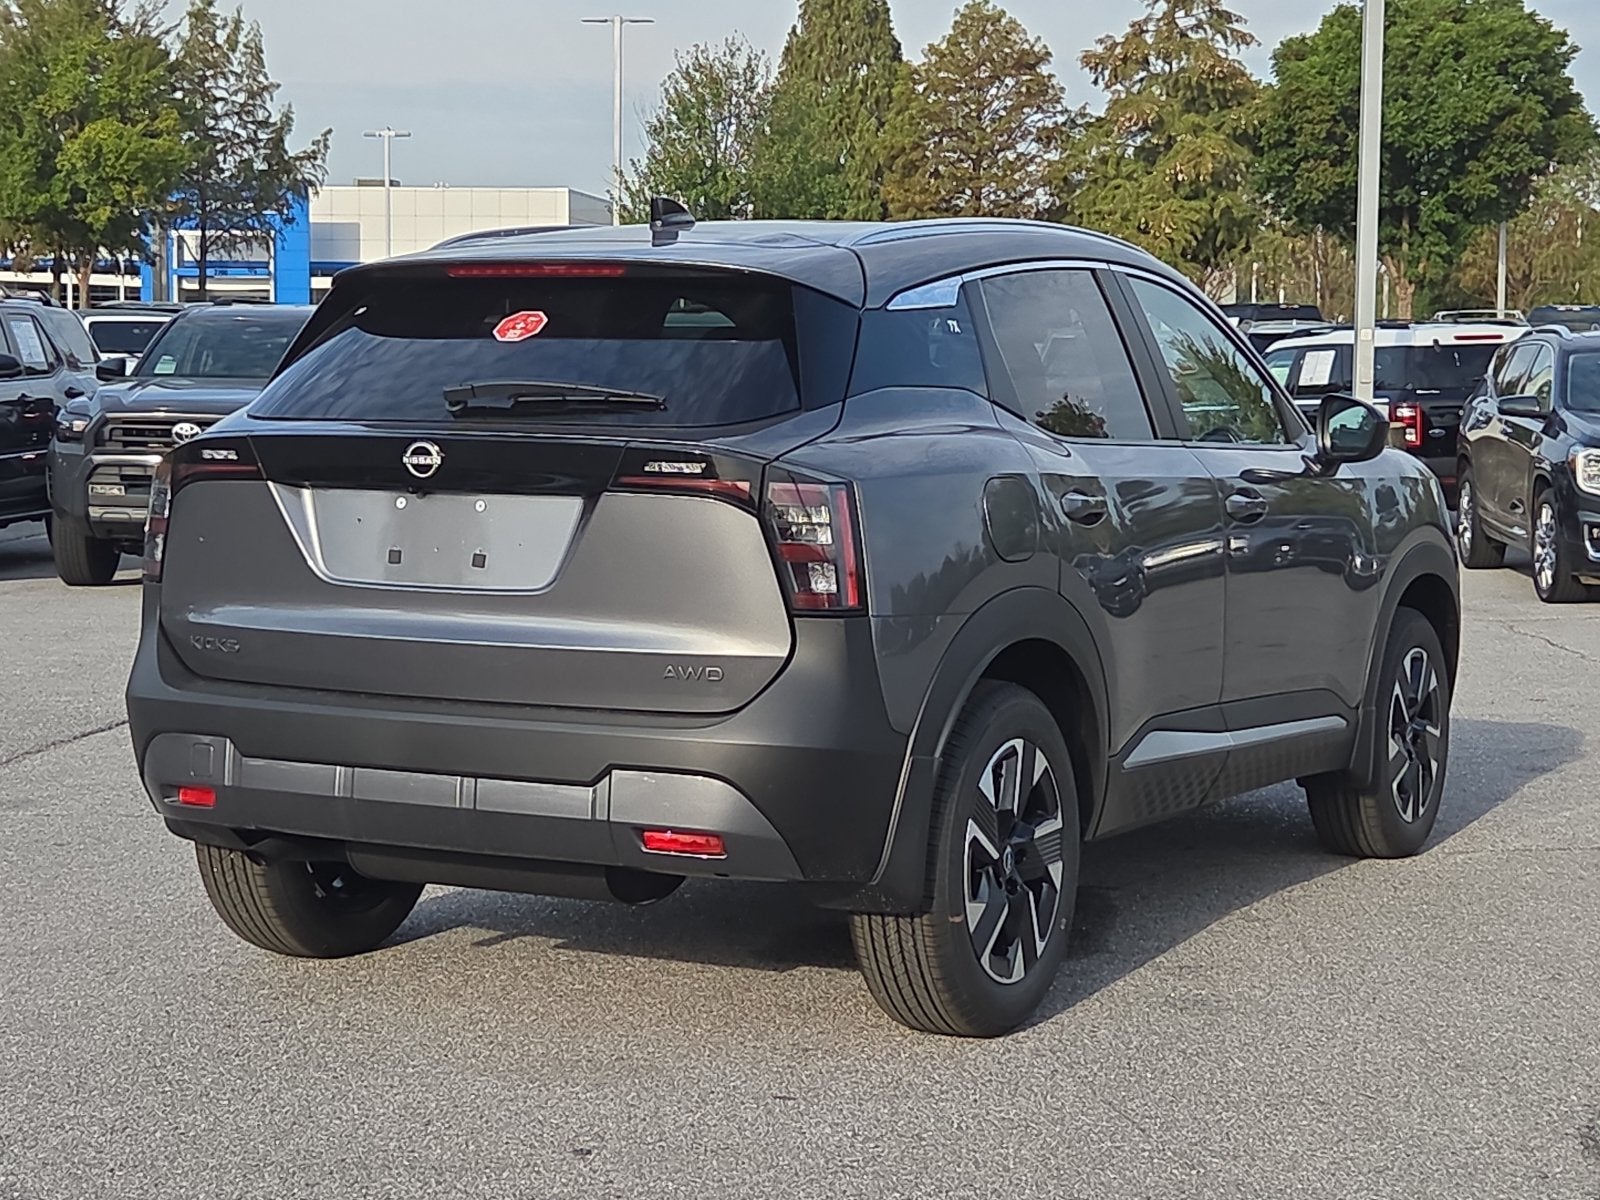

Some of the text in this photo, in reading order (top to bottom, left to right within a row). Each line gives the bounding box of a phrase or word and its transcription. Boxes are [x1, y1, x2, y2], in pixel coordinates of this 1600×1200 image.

[402, 455, 442, 465] NISSAN
[190, 635, 240, 653] KICKS
[663, 664, 724, 682] AWD
